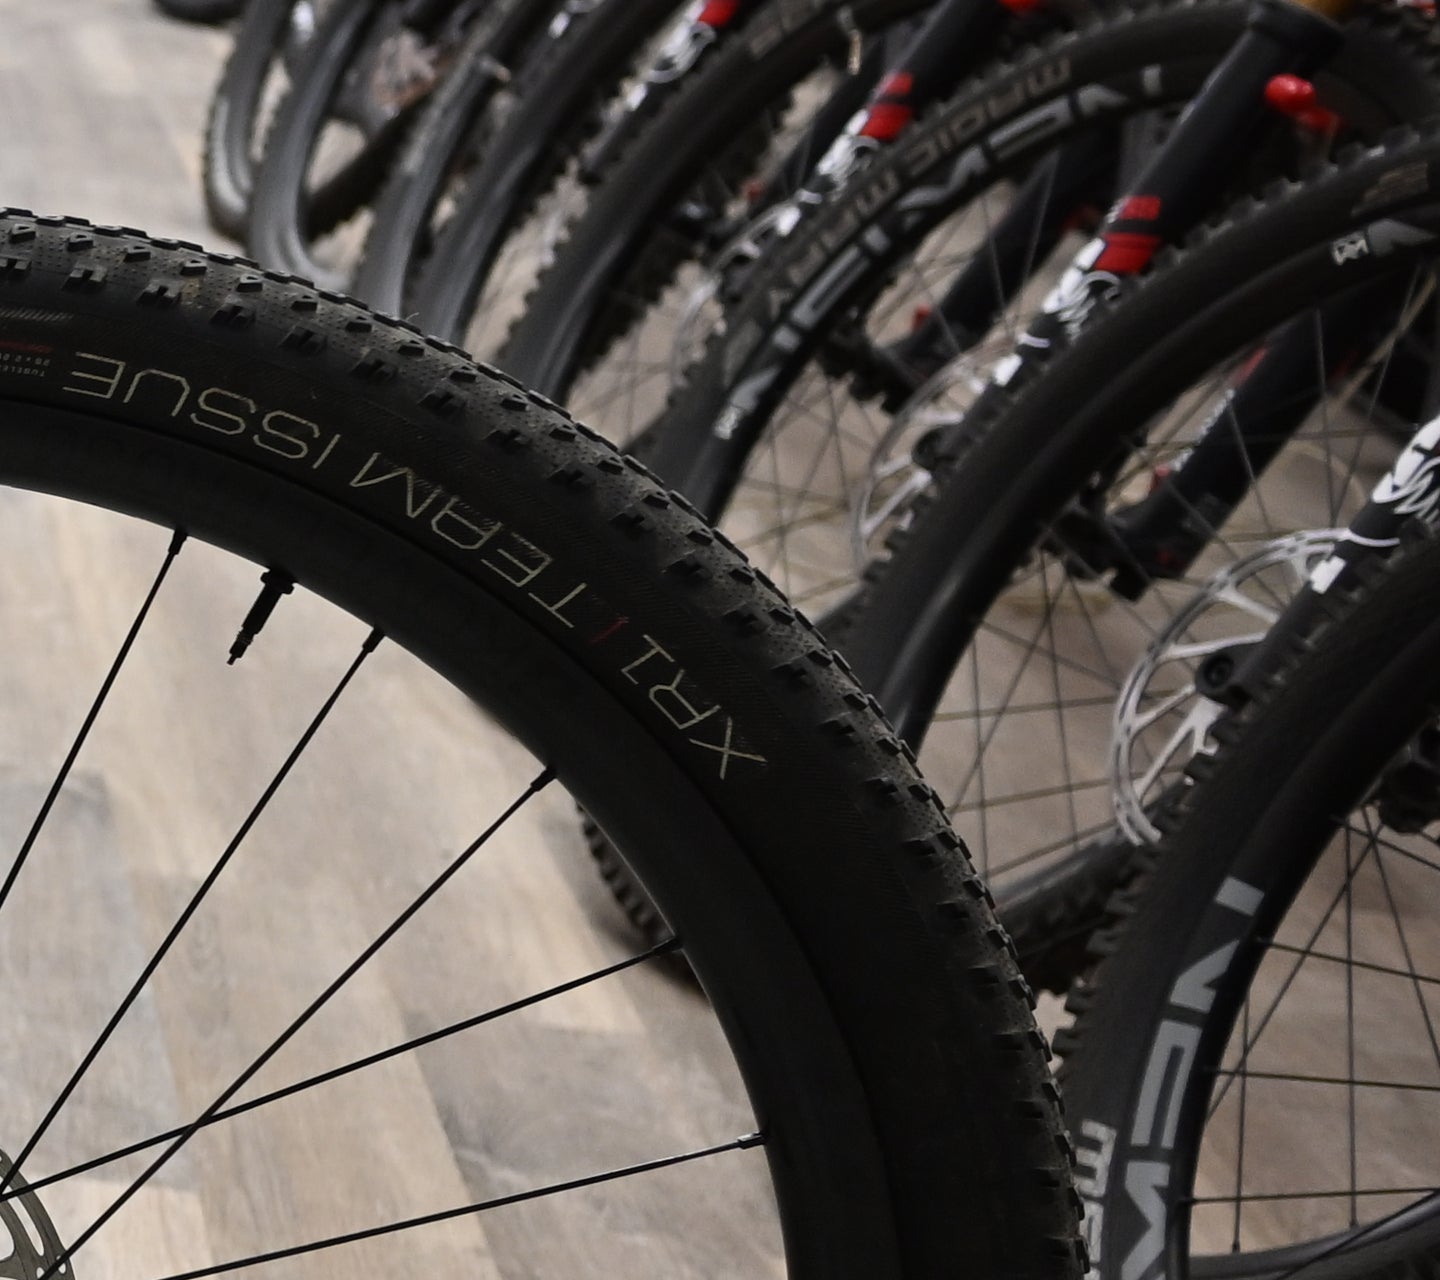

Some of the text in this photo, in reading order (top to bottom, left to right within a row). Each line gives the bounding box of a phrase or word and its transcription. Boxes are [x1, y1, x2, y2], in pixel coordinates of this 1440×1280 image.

[62, 350, 769, 781] XR1 TEAM ISSUE
